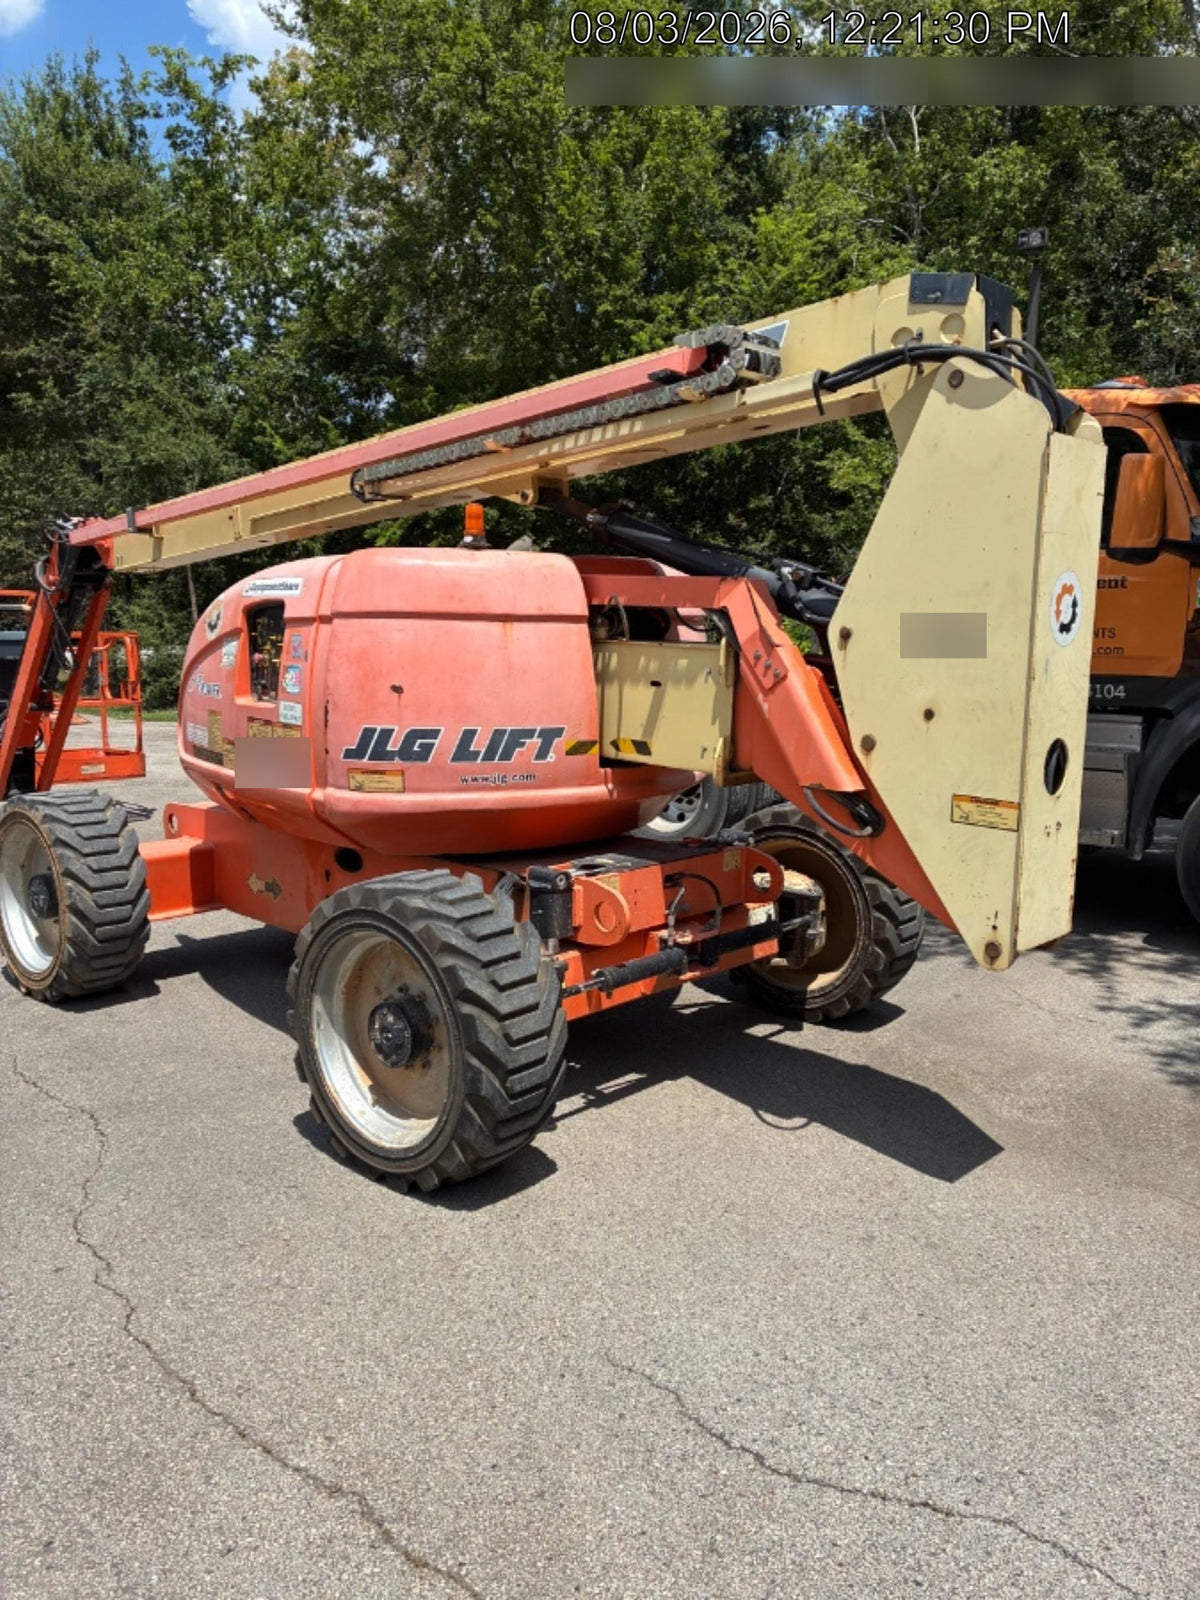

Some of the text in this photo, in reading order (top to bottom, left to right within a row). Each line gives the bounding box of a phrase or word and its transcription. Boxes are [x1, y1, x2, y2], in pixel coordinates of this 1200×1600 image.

[1088, 683, 1126, 699] 104
[342, 725, 566, 764] JLG LIFT
[459, 772, 537, 786] www.jlg.com
